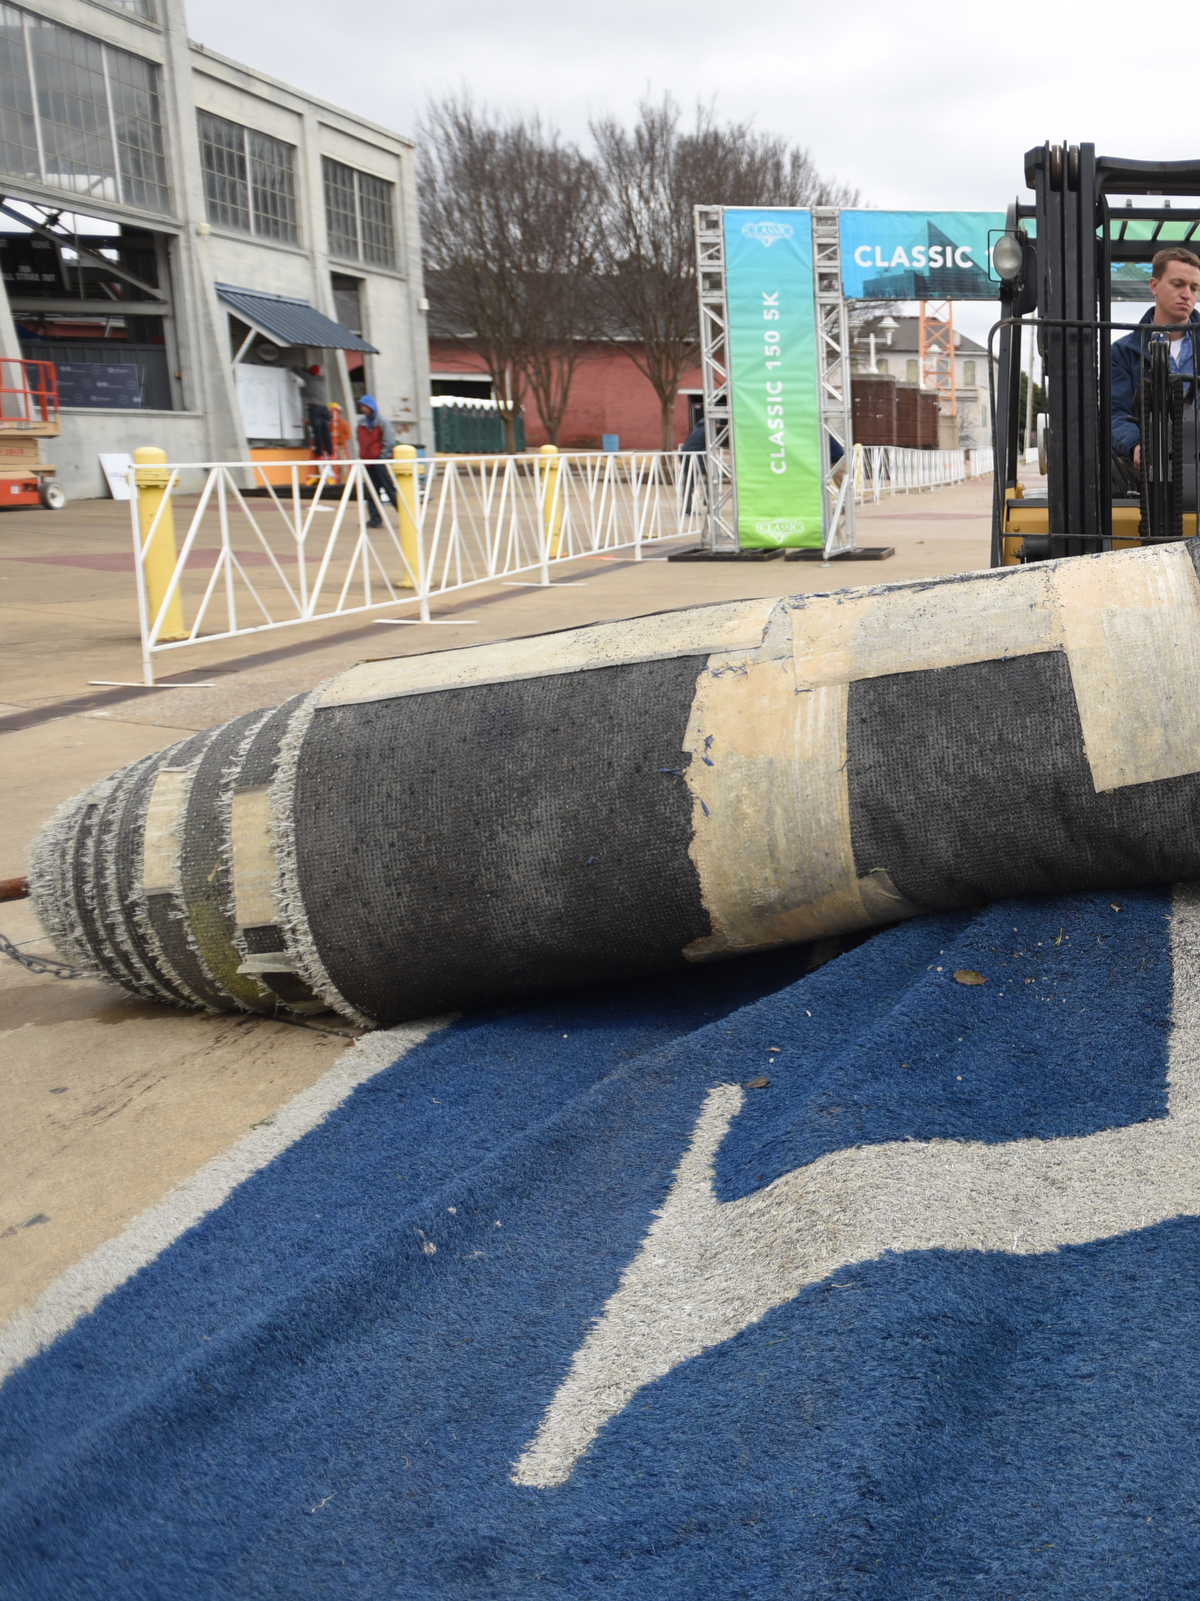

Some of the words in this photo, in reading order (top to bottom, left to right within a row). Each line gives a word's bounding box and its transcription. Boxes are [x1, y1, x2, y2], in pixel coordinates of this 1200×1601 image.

[745, 225, 791, 236] CLASSIC
[854, 245, 974, 268] CLASSIC
[762, 291, 780, 320] 5K
[764, 330, 782, 370] 150
[766, 381, 787, 474] CLASSIC
[759, 521, 801, 532] CLASSIC
